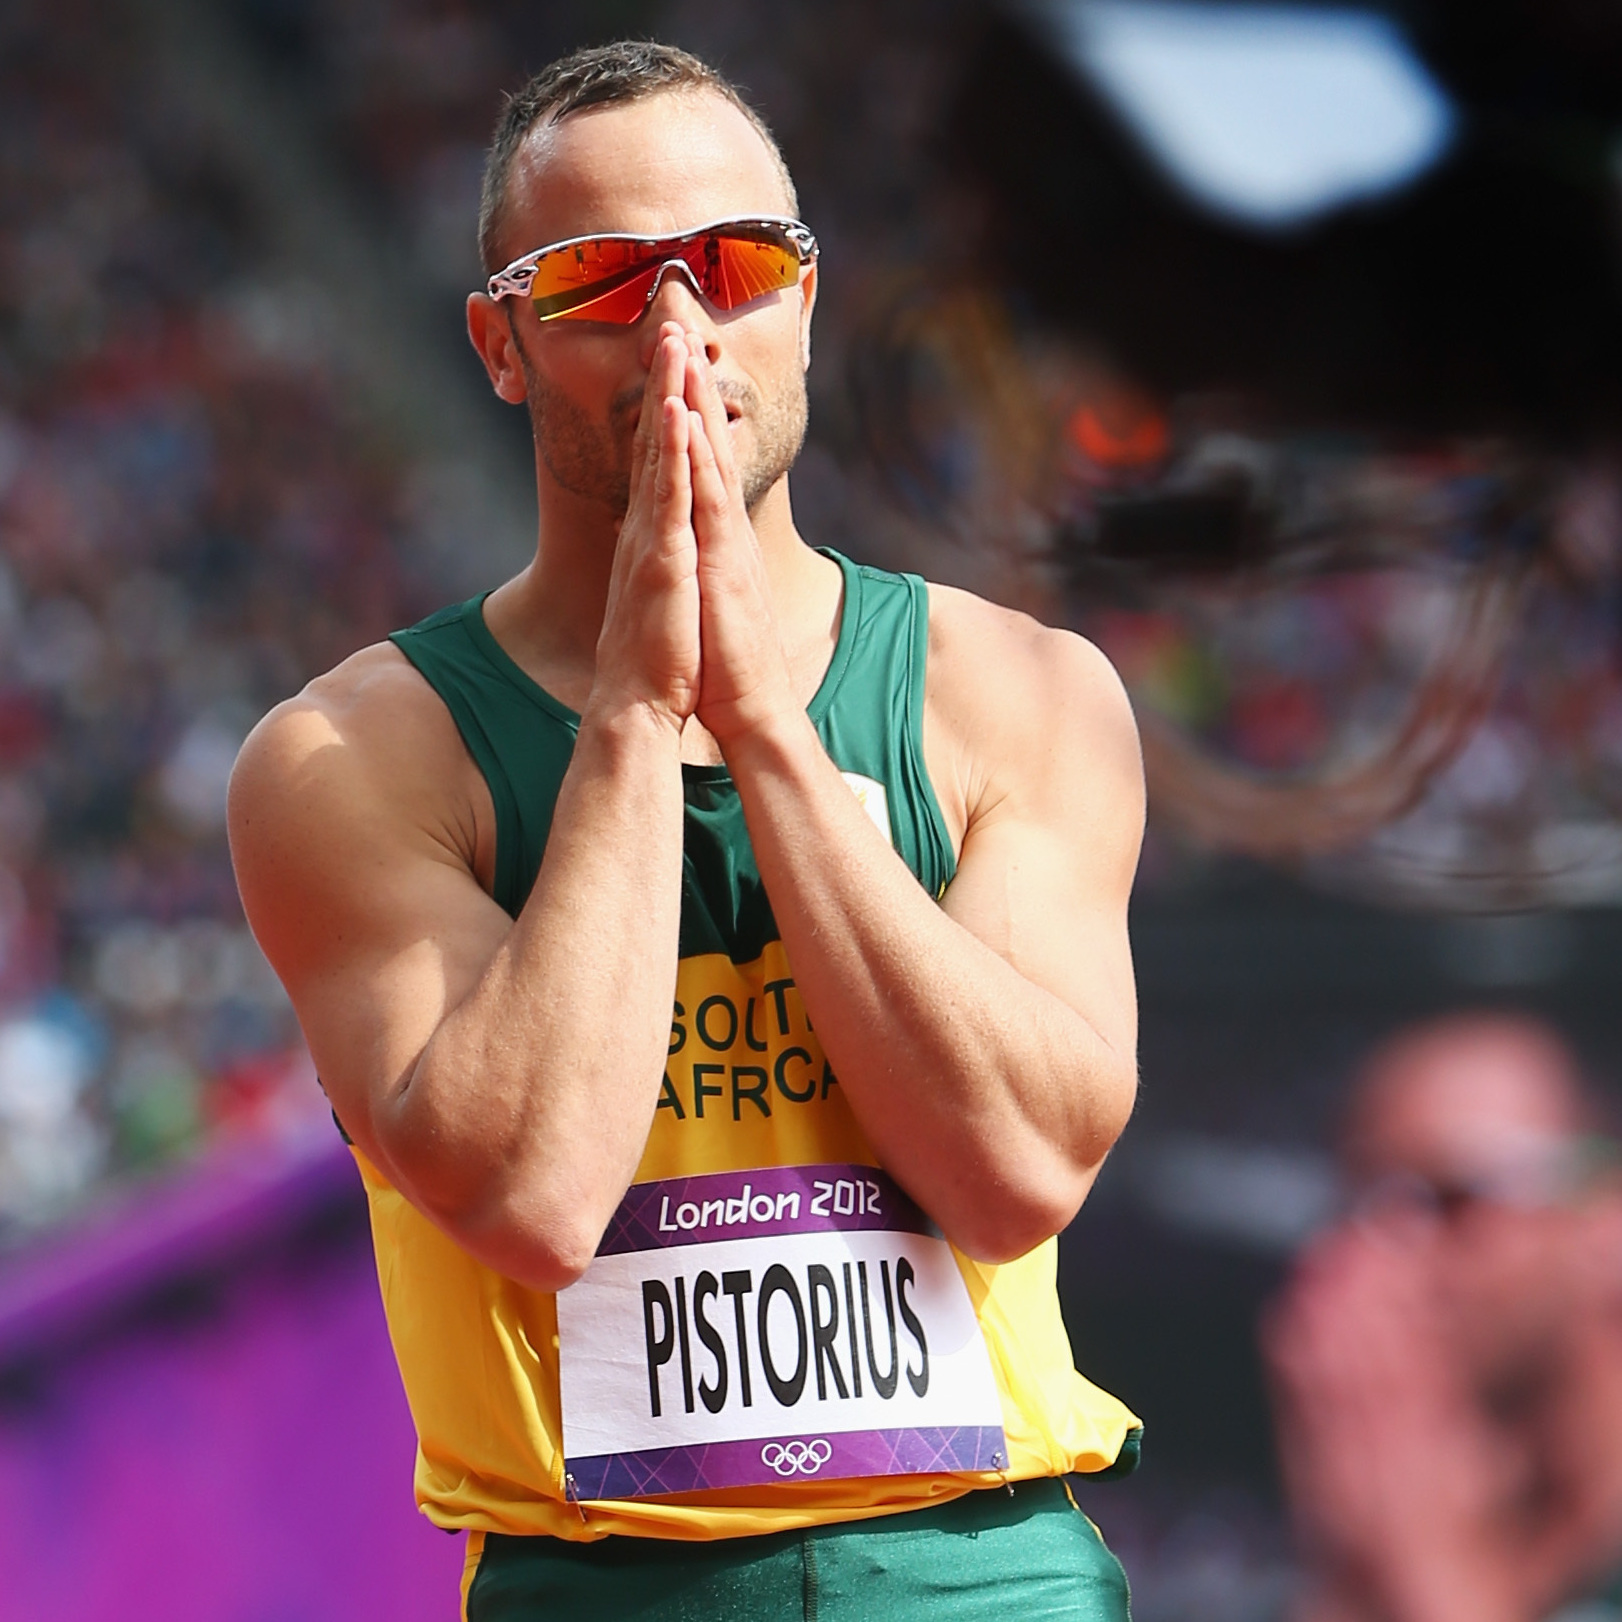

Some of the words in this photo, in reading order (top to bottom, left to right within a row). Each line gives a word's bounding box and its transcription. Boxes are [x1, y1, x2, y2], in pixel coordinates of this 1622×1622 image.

[667, 978, 814, 1056] SOUT
[656, 1046, 839, 1121] AFRC
[658, 1185, 801, 1232] London
[810, 1180, 882, 1217] 2012
[641, 1256, 929, 1418] PISTORIUS
